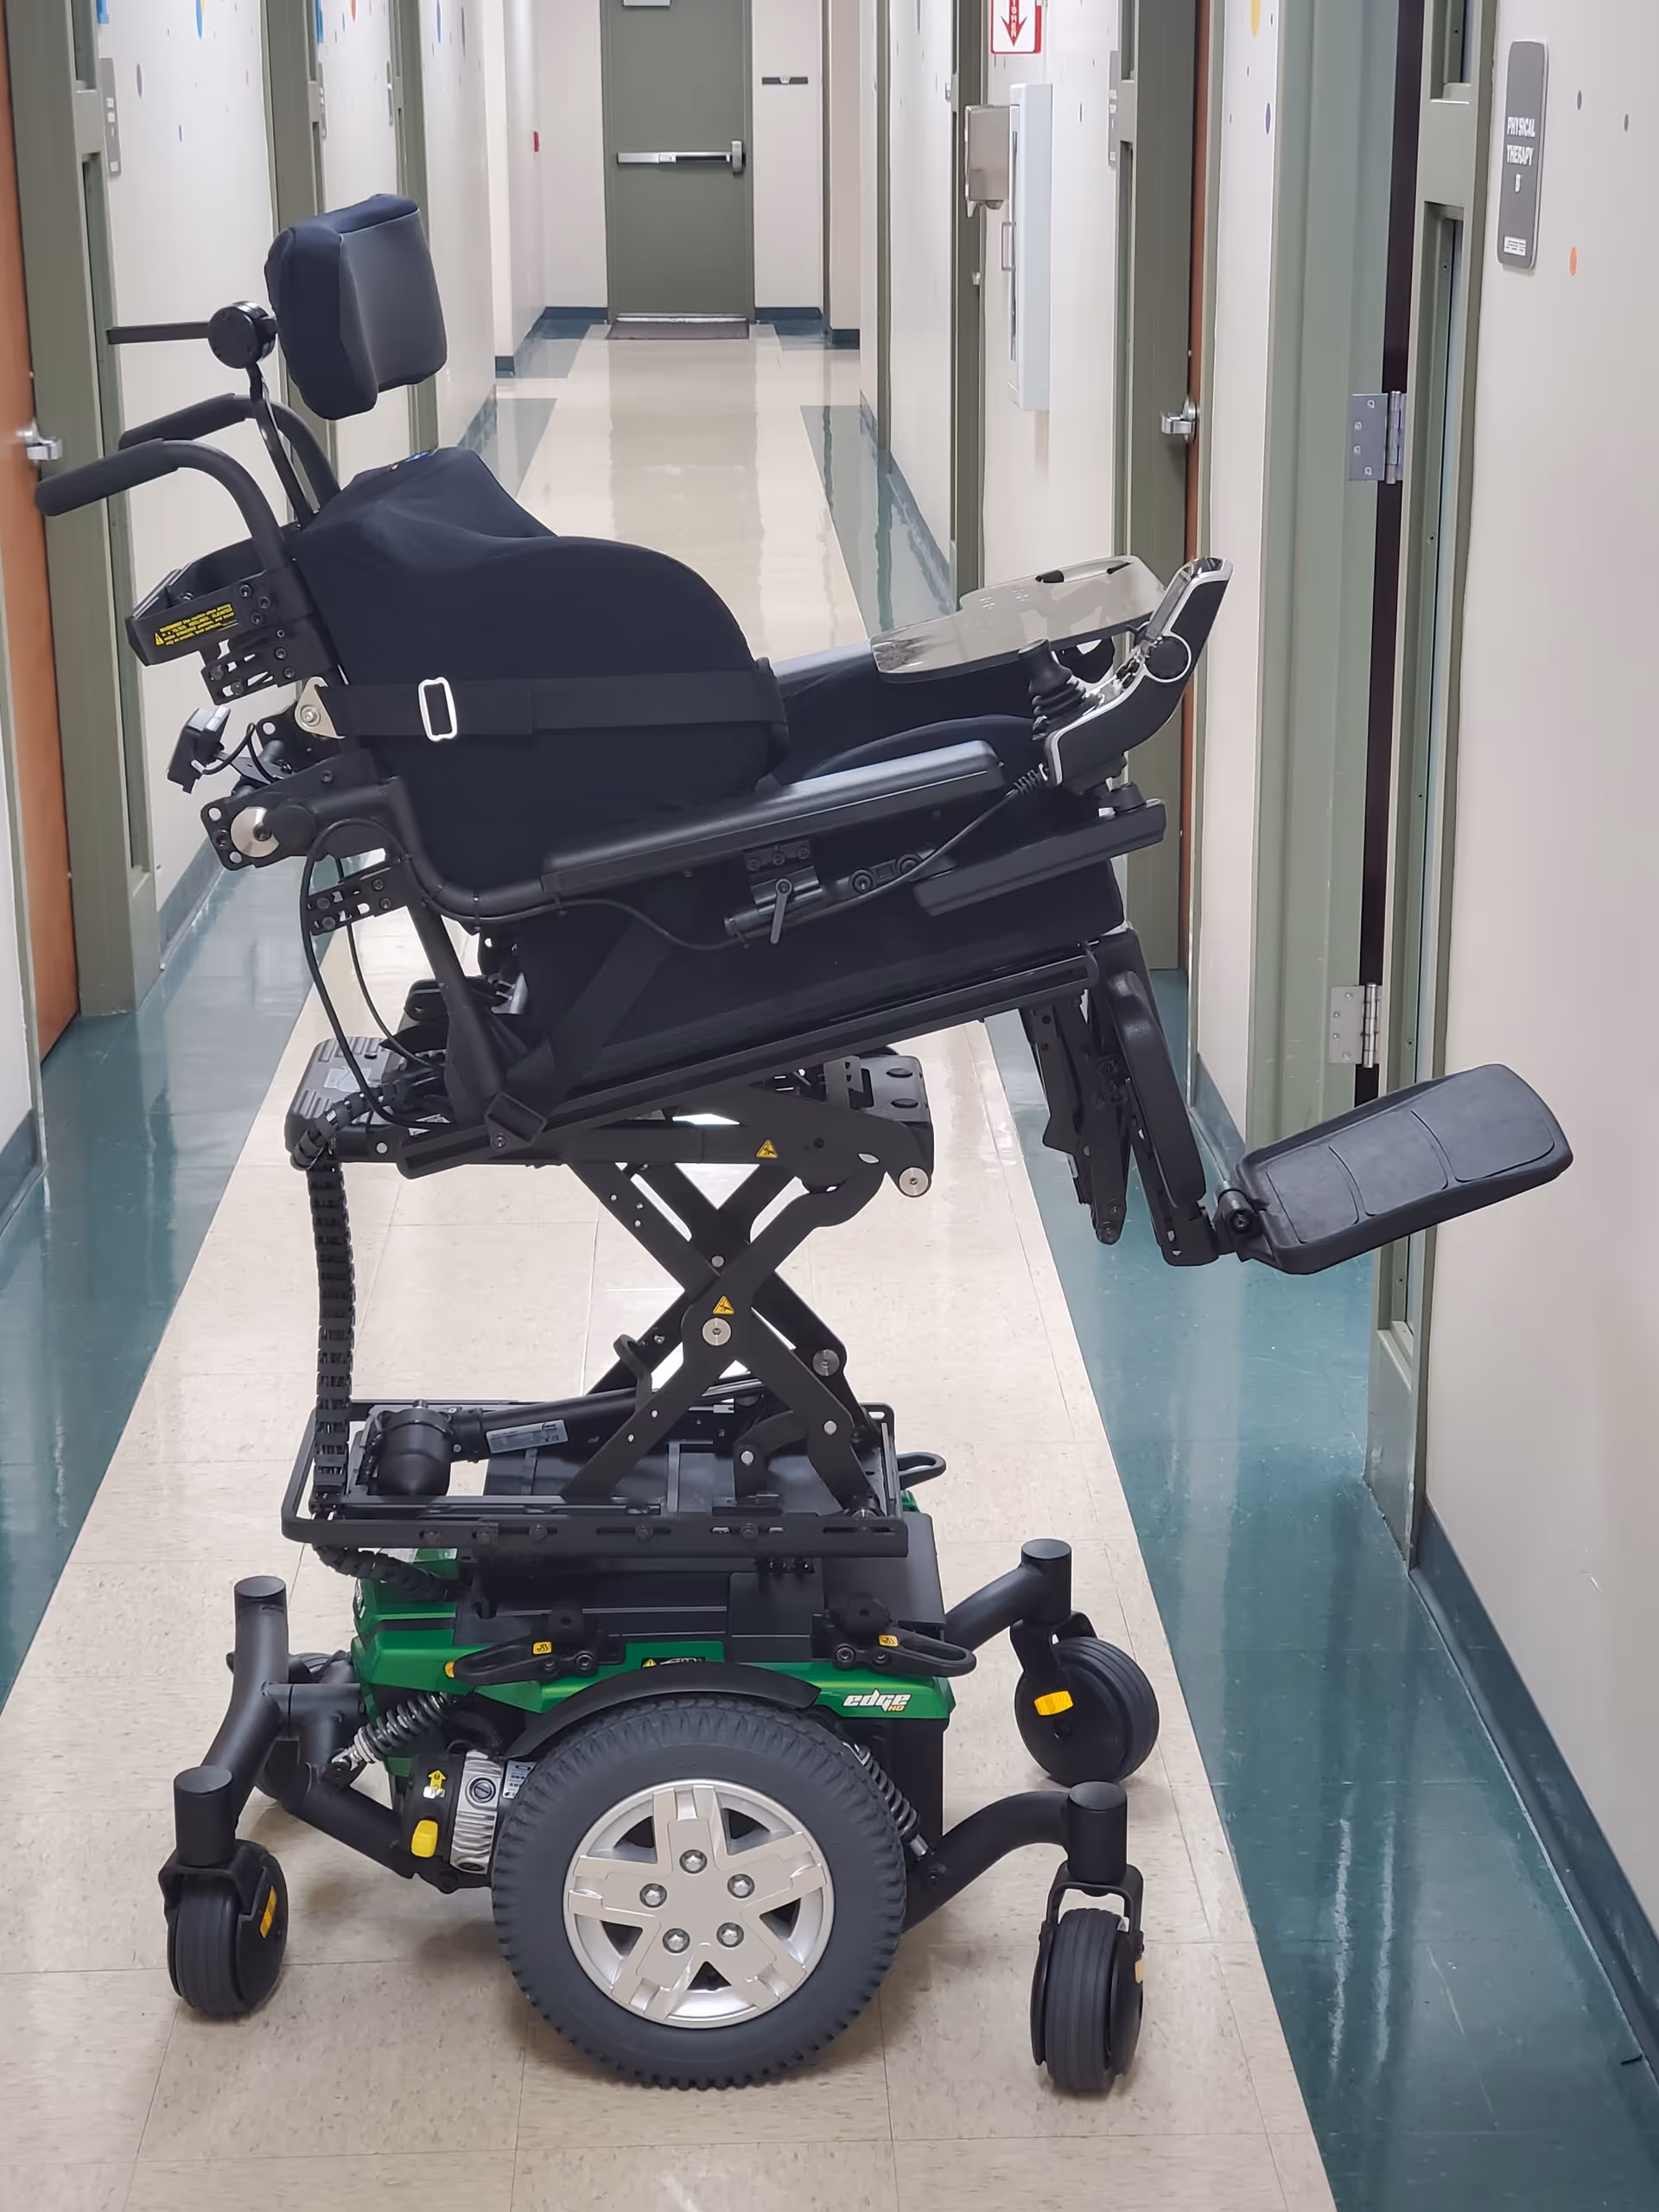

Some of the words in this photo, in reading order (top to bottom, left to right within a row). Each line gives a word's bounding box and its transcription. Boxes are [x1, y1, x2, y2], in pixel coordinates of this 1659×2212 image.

[1507, 116, 1535, 137] PHYSICAL
[1507, 144, 1534, 166] THERAPY
[842, 1688, 911, 1712] edge
